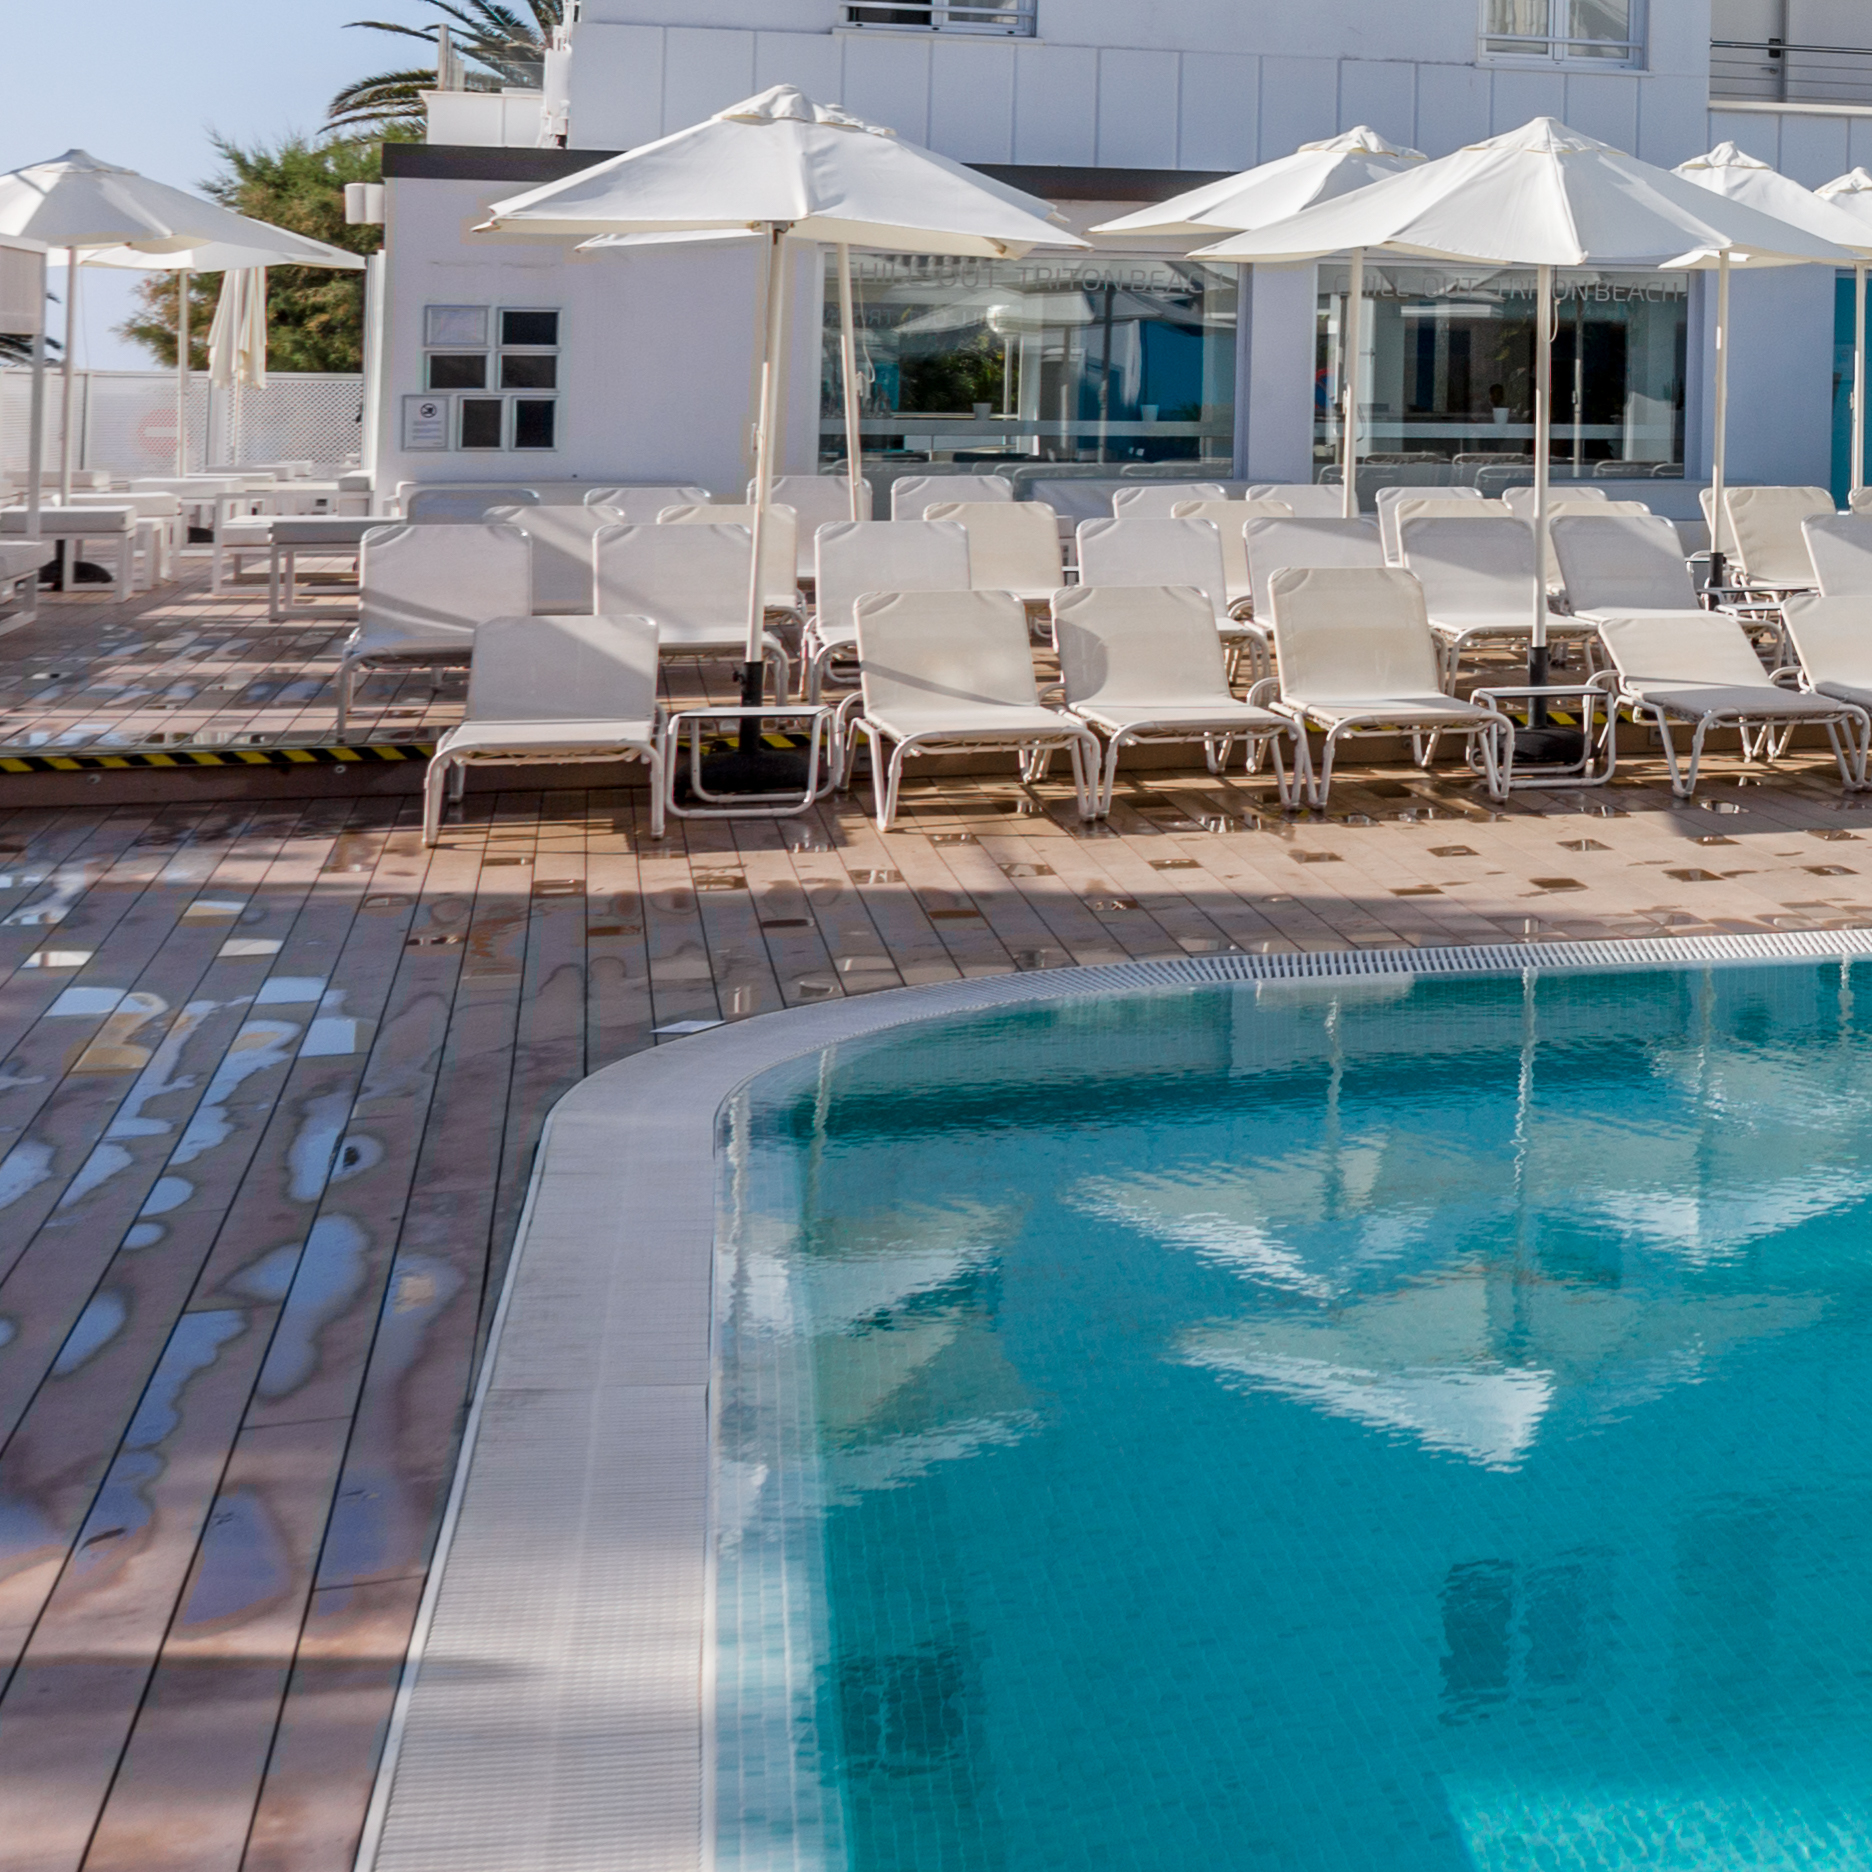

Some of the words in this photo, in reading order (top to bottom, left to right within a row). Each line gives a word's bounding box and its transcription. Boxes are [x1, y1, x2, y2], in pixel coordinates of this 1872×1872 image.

[1016, 266, 1123, 292] TRITON
[1493, 279, 1589, 301] TRION
[1594, 280, 1678, 302] BEACH
